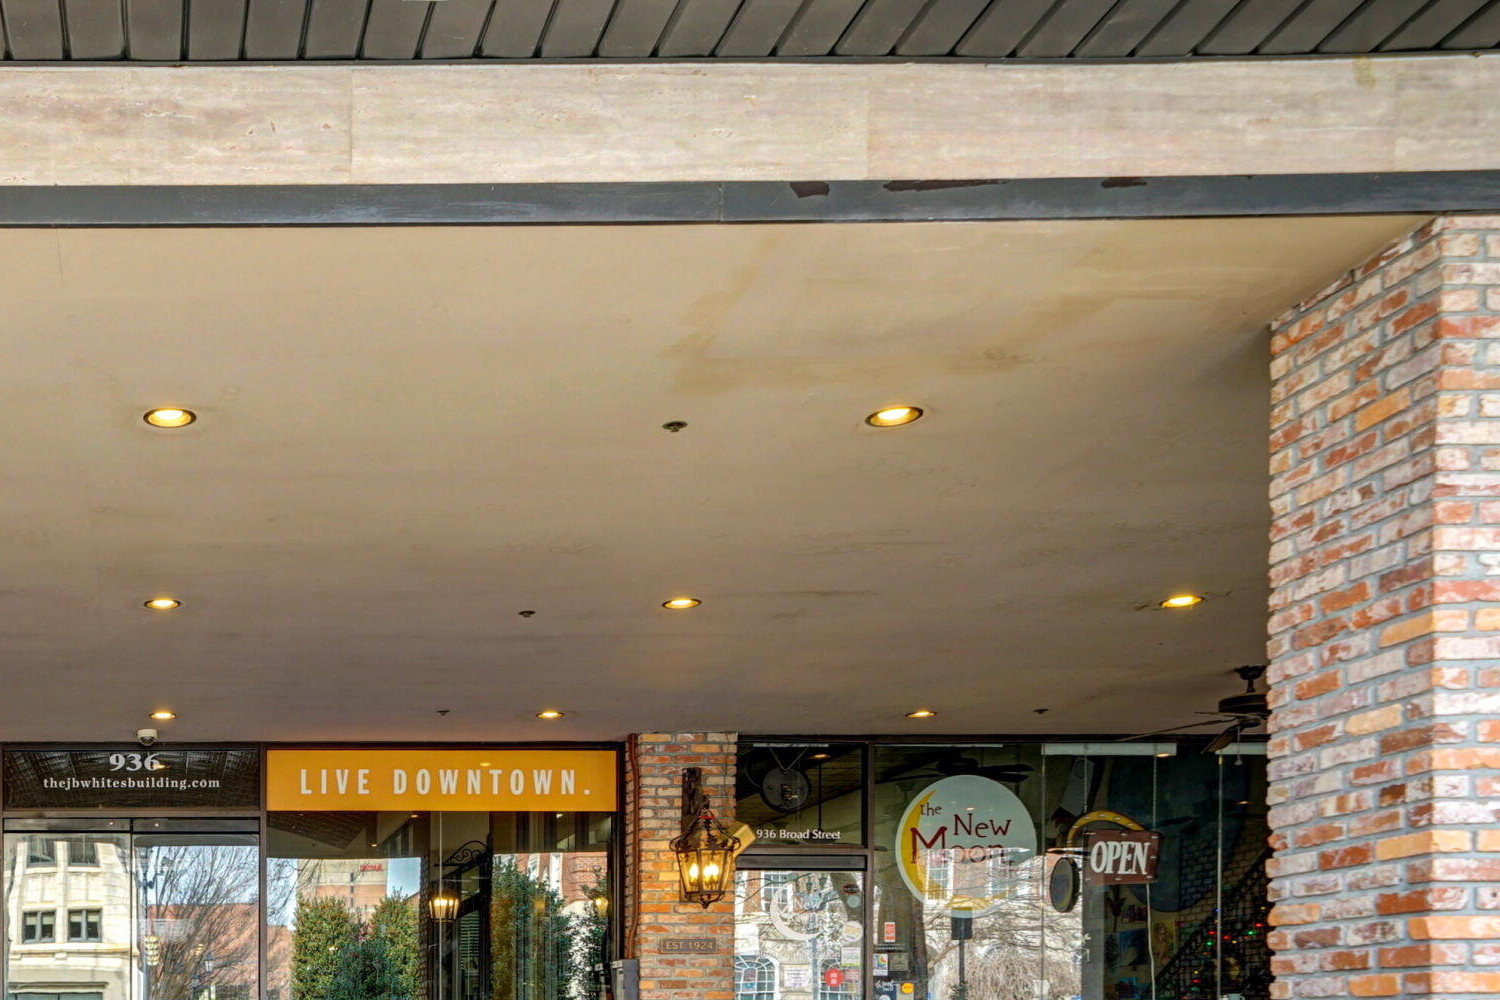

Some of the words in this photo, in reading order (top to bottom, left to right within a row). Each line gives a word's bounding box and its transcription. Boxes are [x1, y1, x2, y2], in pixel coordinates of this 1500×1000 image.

[109, 753, 161, 772] 936
[43, 777, 220, 790] thejbwhitesbuilding.com
[300, 769, 370, 795] LIVE
[393, 769, 591, 795] DOWNTOWN.
[920, 802, 942, 816] the
[953, 813, 1012, 838] New
[756, 829, 776, 839] 936
[779, 828, 809, 839] Broad
[812, 829, 841, 839] Street
[910, 826, 1007, 864] Moon
[1090, 841, 1151, 875] OPEN
